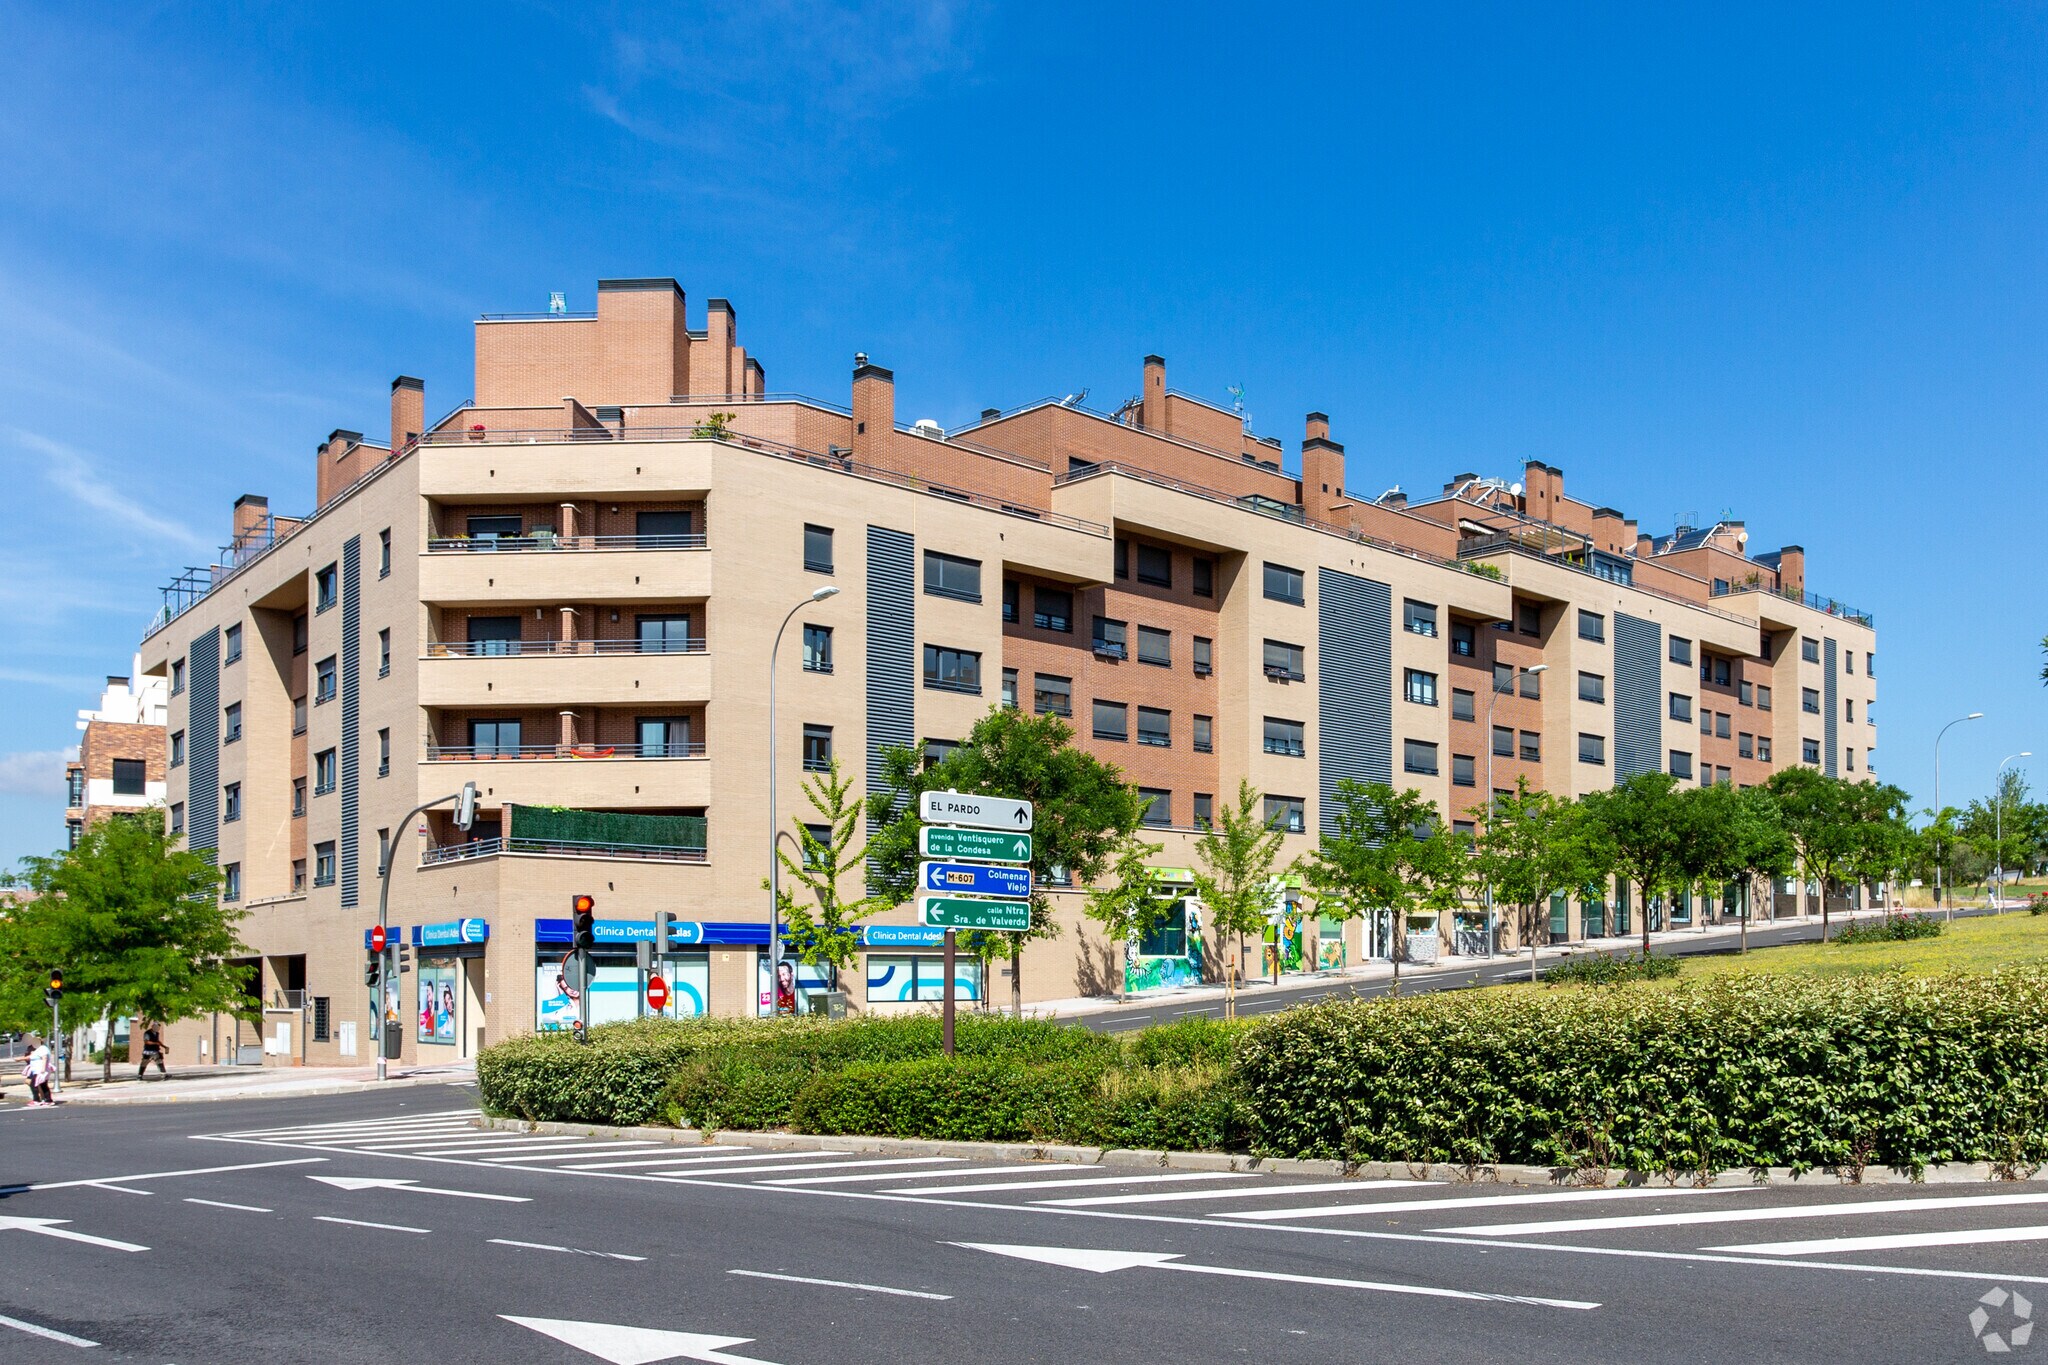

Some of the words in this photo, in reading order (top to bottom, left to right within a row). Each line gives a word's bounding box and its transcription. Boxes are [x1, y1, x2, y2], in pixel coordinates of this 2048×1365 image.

[931, 801, 942, 811] EL
[948, 803, 980, 815] PARDO
[930, 833, 954, 841] avenida
[958, 833, 1004, 845] Ventisquero
[930, 843, 941, 852] de
[944, 843, 953, 852] la
[957, 844, 991, 855] Condesa
[947, 872, 974, 883] M-607
[988, 870, 1028, 881] Colmenar
[1007, 882, 1027, 893] Viejo
[987, 907, 1003, 915] calle
[1005, 905, 1027, 915] Ntra.
[953, 914, 972, 924] Sra.
[976, 916, 986, 925] de
[991, 916, 1027, 926] Valverde
[594, 926, 625, 937] Clínica
[626, 926, 656, 937] Dental
[898, 931, 921, 940] Dental
